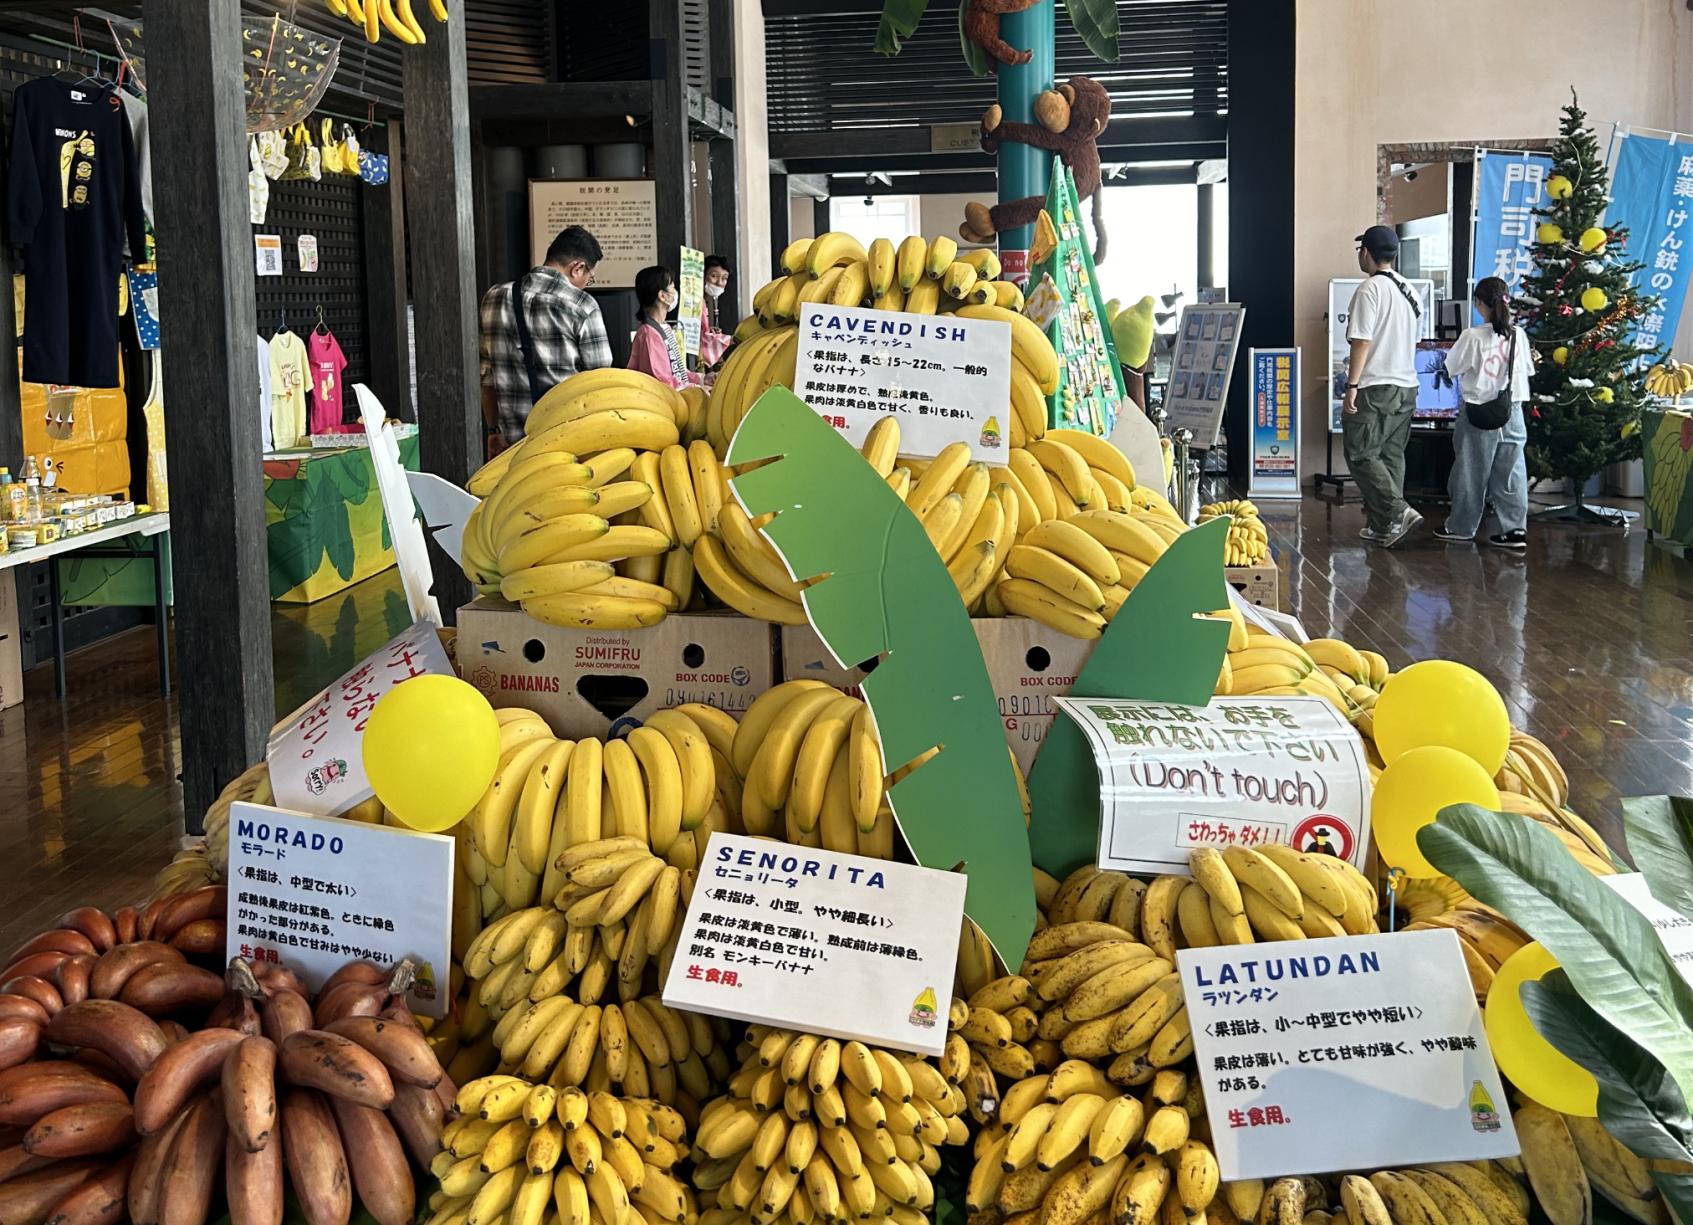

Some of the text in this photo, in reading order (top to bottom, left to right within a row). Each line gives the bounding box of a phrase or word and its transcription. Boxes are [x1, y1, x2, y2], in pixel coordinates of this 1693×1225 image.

[1493, 163, 1544, 297] 門司税
[810, 314, 966, 342] CAVENDISH
[822, 414, 850, 429] 用。
[575, 646, 641, 662] SUMIFRU
[586, 637, 630, 647] Distributed by
[574, 661, 641, 670] JAPAN CORPORATION
[500, 674, 560, 693] BANANAS
[676, 673, 698, 682] BOX
[701, 674, 730, 684] CODE
[1020, 677, 1044, 687] BOX
[1087, 705, 1301, 730] 展示には、お手を
[1106, 722, 1340, 762] 触れないで下さい
[1129, 752, 1329, 810] (Don't touch)
[238, 819, 344, 855] MORADO
[241, 842, 286, 860] モラード
[715, 866, 799, 888] セニョリータ
[717, 846, 885, 889] SENORITA
[238, 892, 395, 932] 成熟後果皮は紅紫色。ときに緑色
[238, 908, 335, 936] がかった部分がある。
[694, 928, 829, 962] 果肉は淡黄白色で甘い。
[699, 912, 924, 962] 果皮は淡黄色で薄い。熟成前は薄緑色。
[239, 943, 283, 965] 生食用。
[689, 944, 814, 975] 別名 モンキーバナナ
[686, 964, 744, 988] 生食用。
[1195, 951, 1381, 987] LATUNDAN
[1202, 987, 1279, 1007] ラツンダン
[1213, 1036, 1478, 1071] 果皮は薄い。とても甘味が強く、やや酸味
[1218, 1076, 1267, 1093] がある。
[1228, 1105, 1292, 1129] 生食用。
